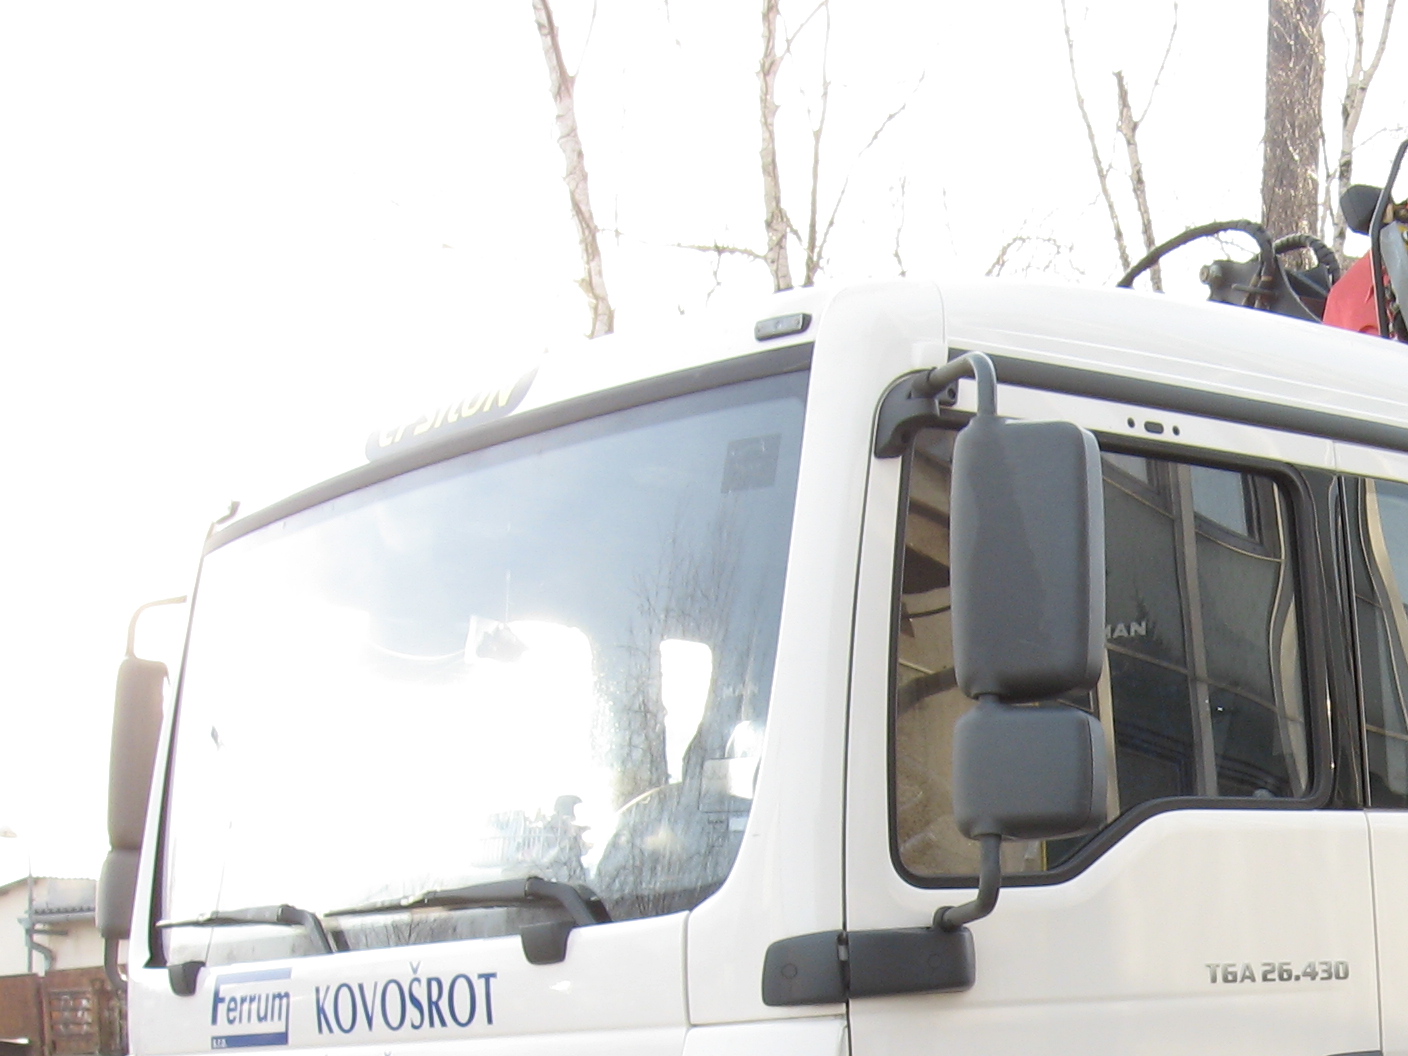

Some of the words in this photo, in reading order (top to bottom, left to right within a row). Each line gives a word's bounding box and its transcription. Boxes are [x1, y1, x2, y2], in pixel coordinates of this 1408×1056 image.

[211, 968, 291, 1030] Ferrum
[315, 962, 498, 1035] KOVOŠROT
[1205, 962, 1256, 983] TGA
[1261, 960, 1350, 982] 26.430
